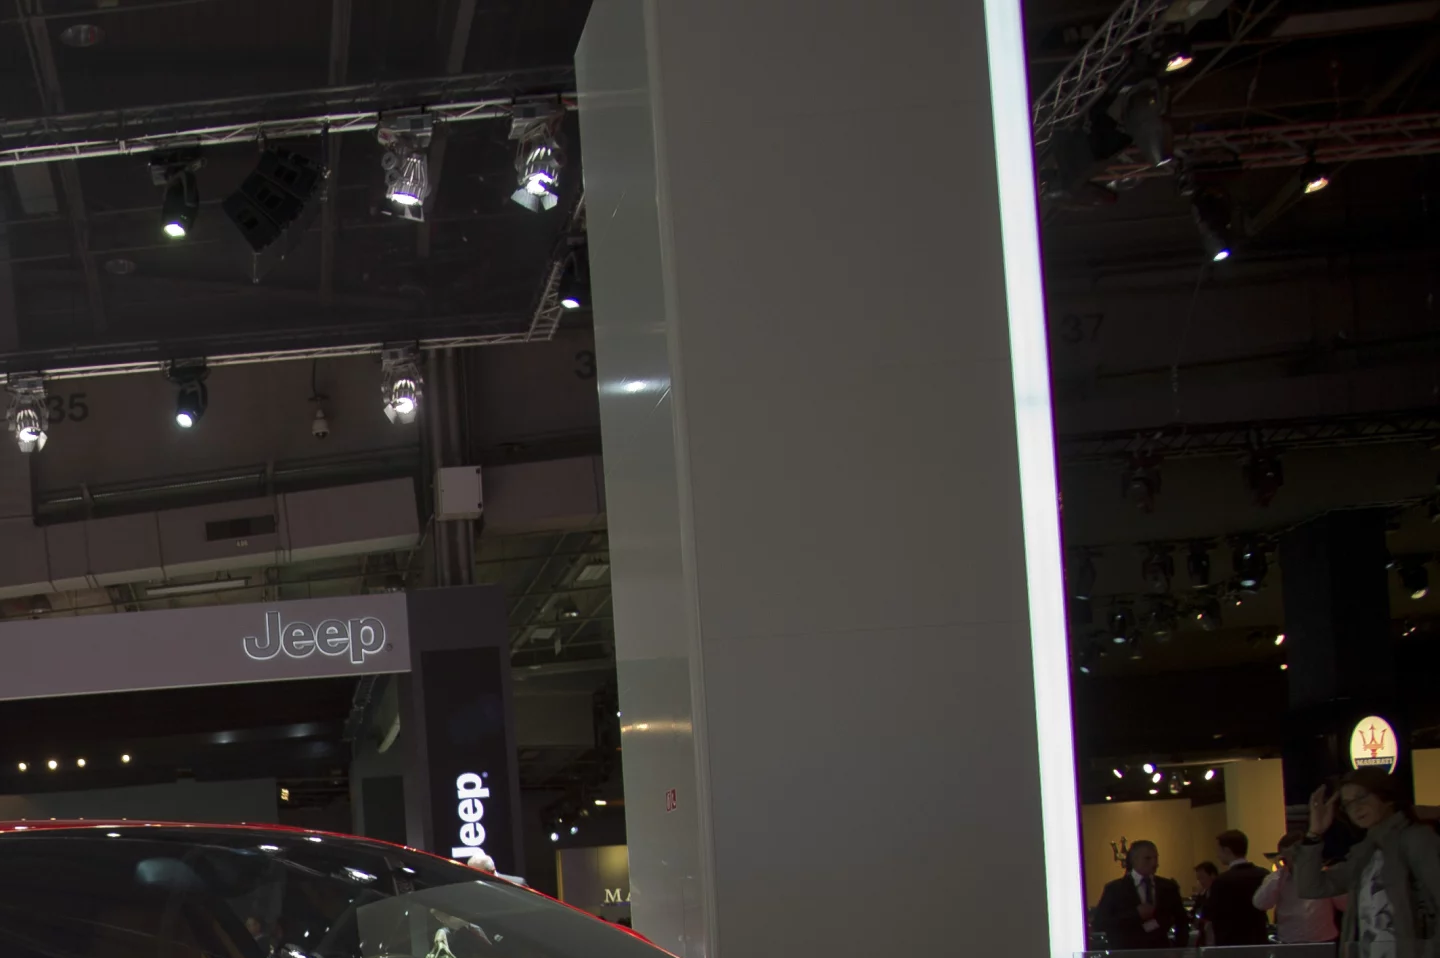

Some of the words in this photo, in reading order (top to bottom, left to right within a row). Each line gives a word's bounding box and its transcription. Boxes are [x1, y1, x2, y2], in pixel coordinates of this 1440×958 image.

[1061, 312, 1105, 344] 37
[574, 350, 597, 380] 3
[46, 393, 89, 423] 35
[243, 611, 386, 664] Jeep
[1356, 757, 1394, 766] MASERATI
[451, 771, 490, 859] Jeep
